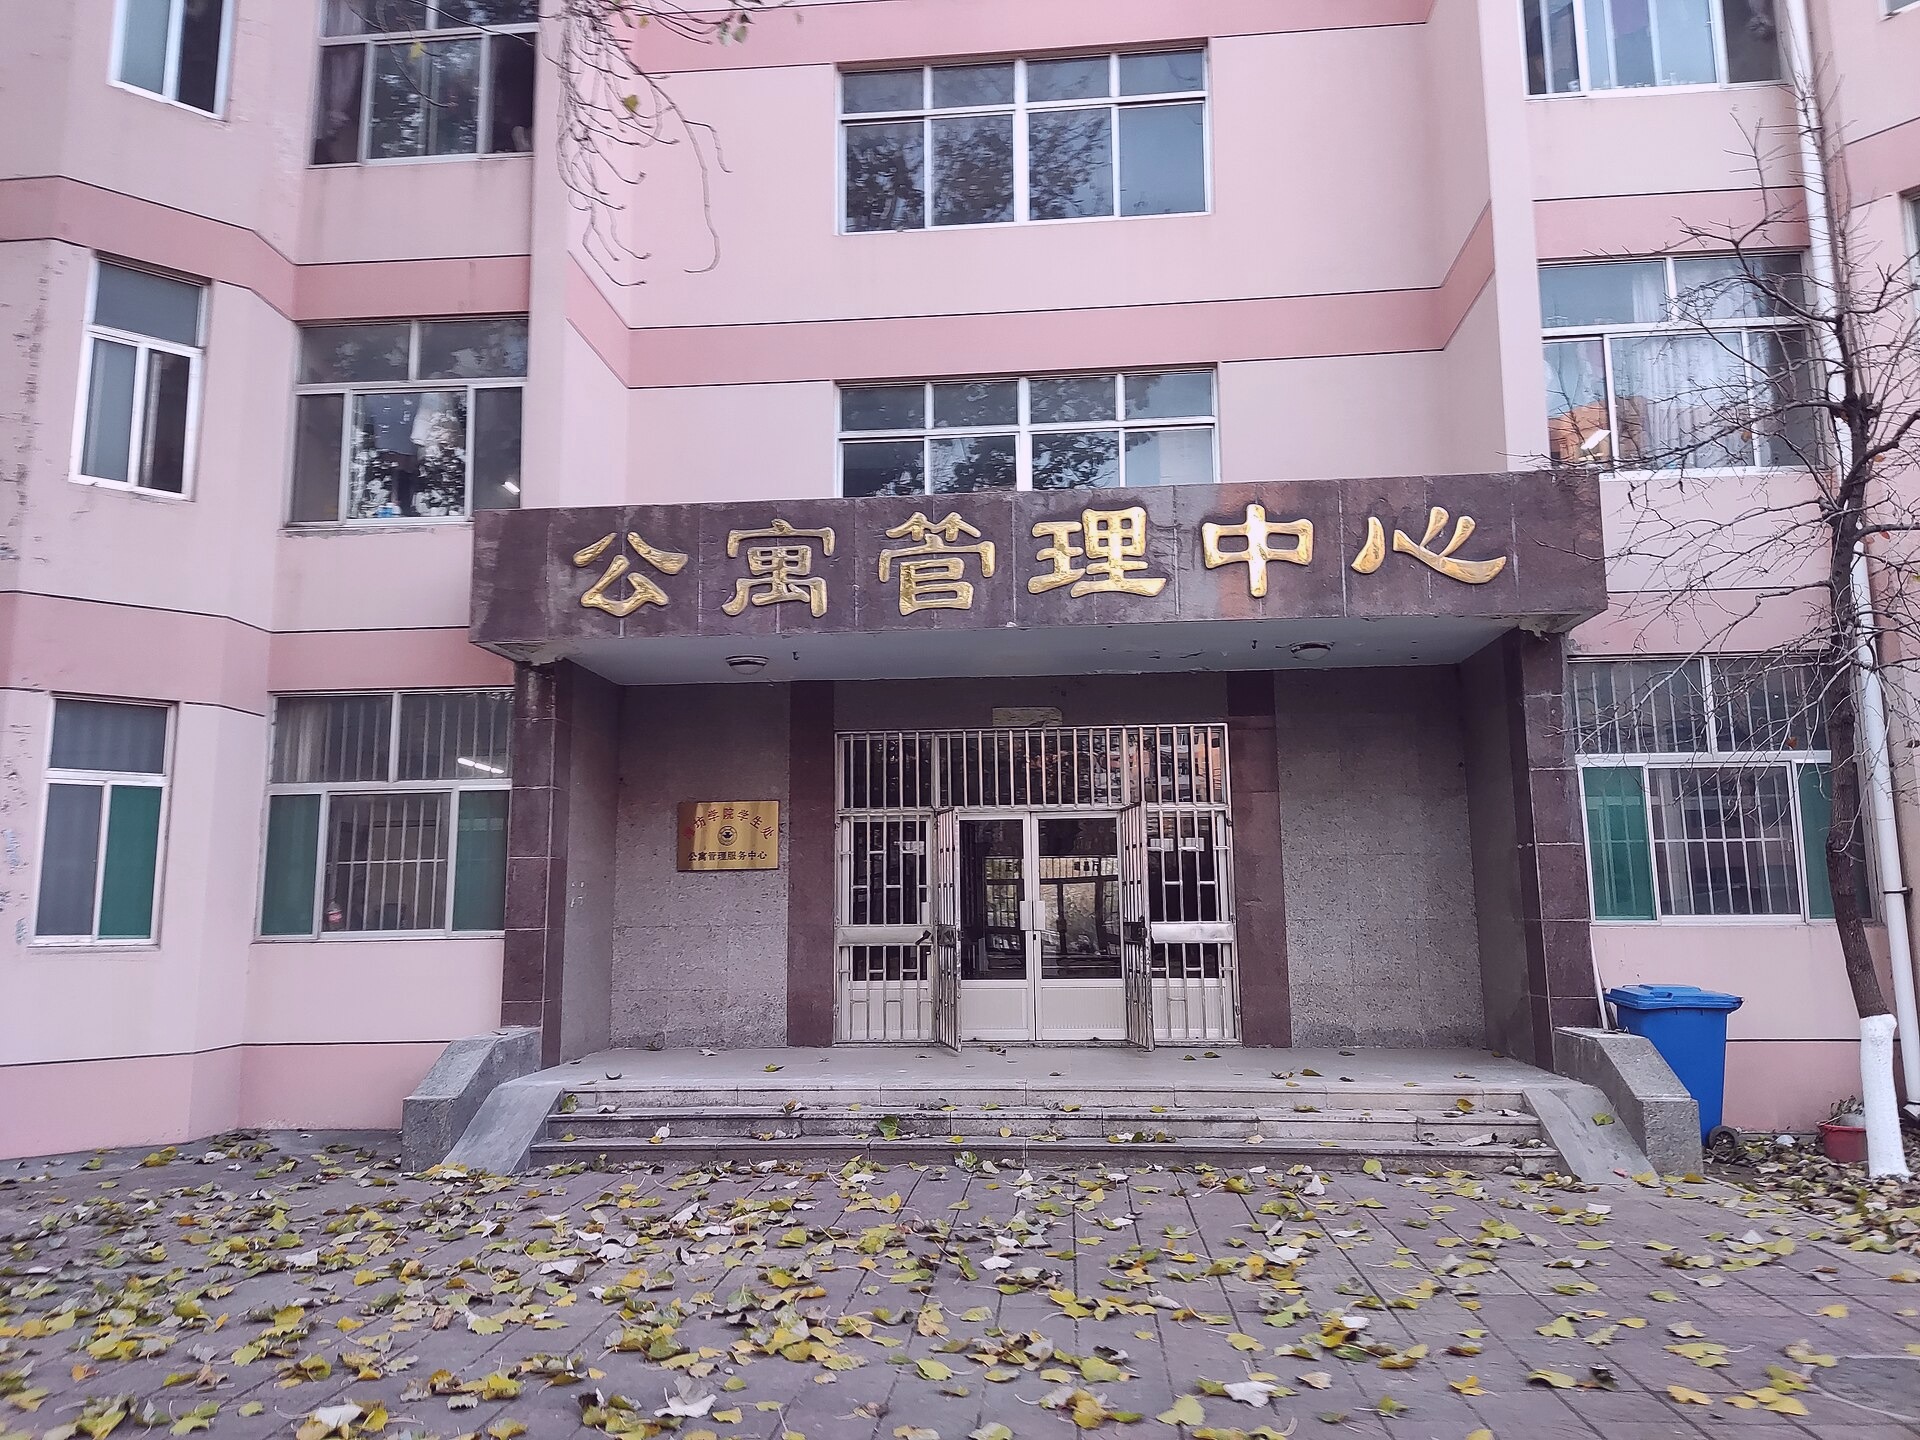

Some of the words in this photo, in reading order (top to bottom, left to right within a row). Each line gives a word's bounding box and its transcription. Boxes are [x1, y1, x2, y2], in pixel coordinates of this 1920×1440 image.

[572, 503, 1508, 618] 公寓管理中心
[688, 850, 768, 862] 公寓管理服务中心
